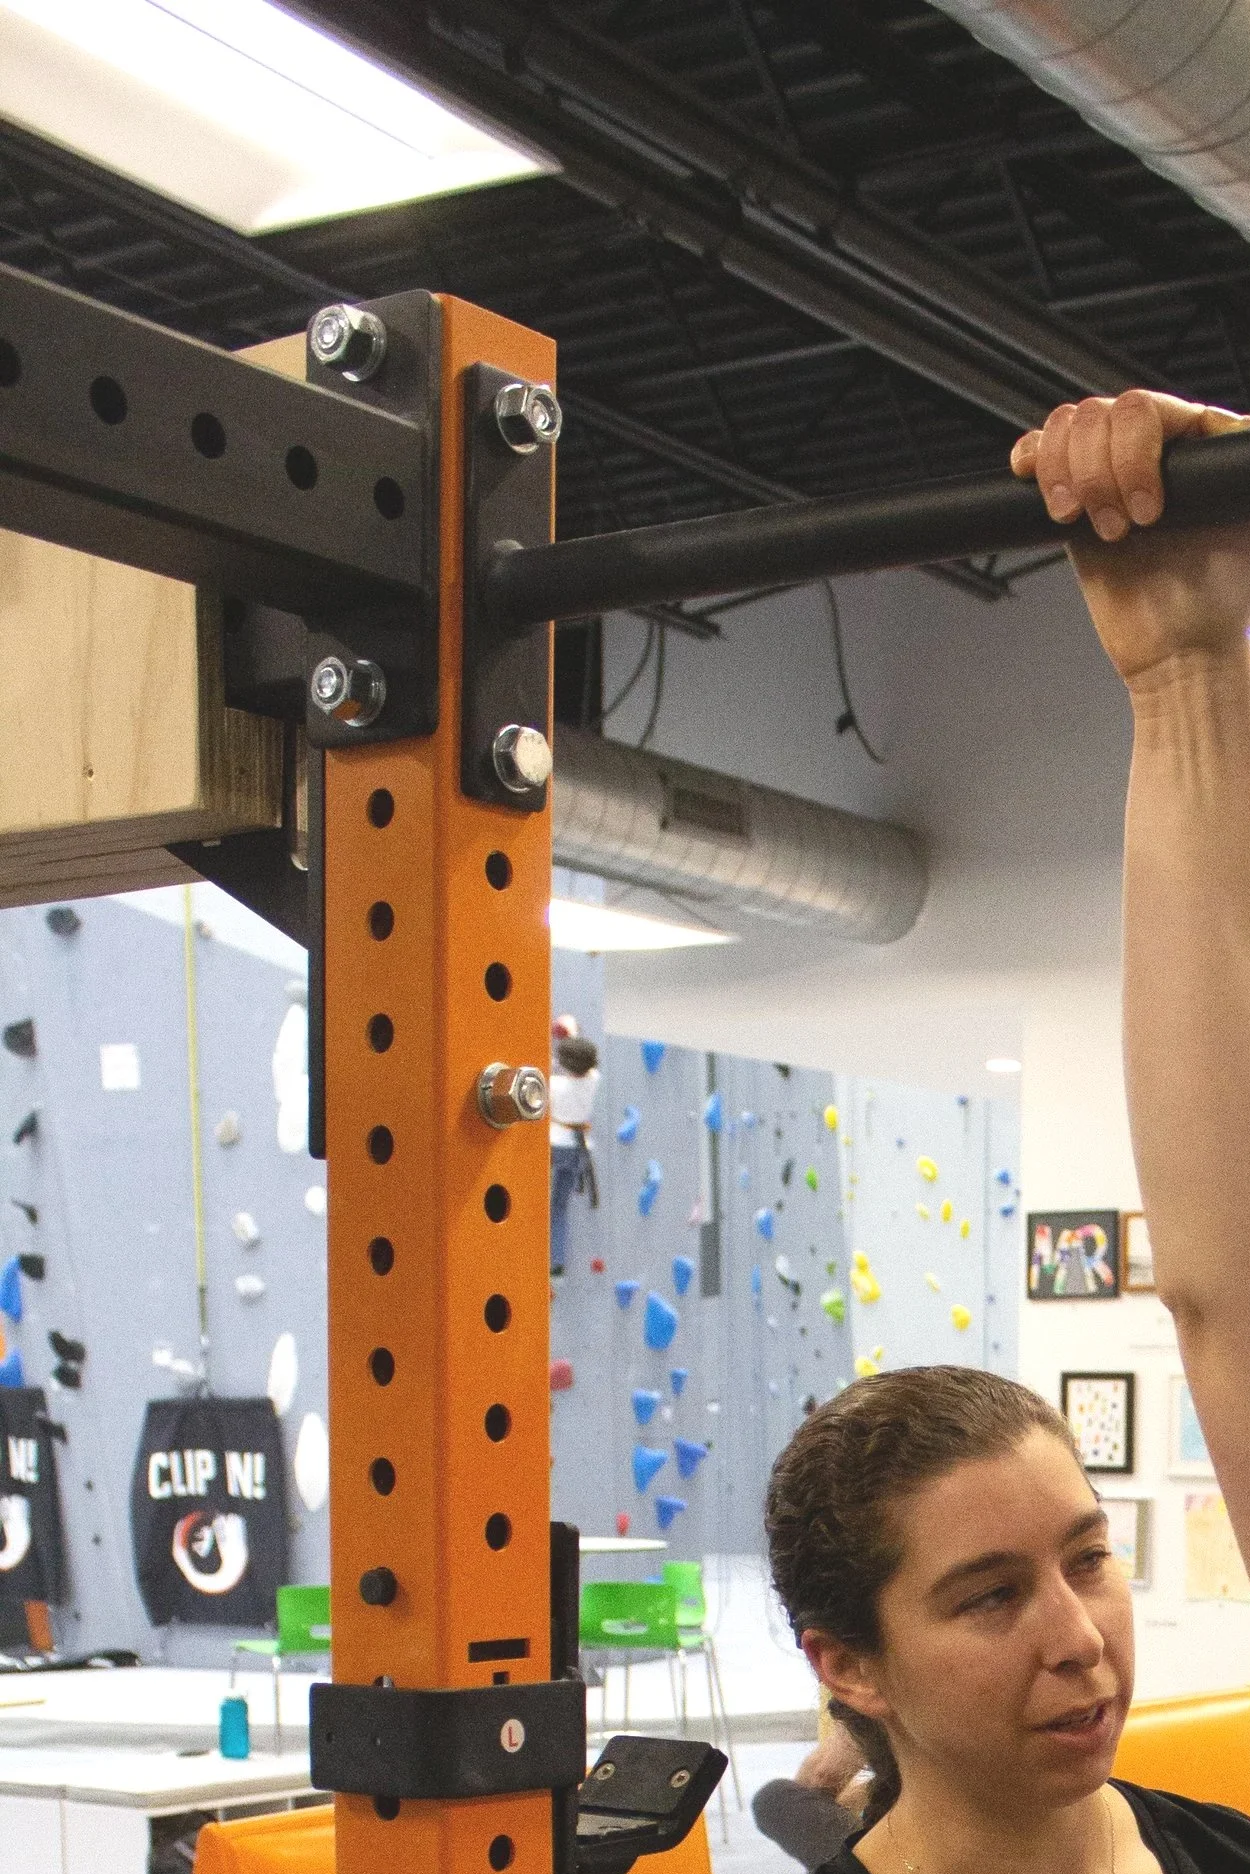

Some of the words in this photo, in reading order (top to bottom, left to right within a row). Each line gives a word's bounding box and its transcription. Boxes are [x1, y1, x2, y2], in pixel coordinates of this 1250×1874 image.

[148, 1449, 217, 1500] CLIP
[225, 1451, 266, 1500] N!
[508, 1726, 519, 1748] L
